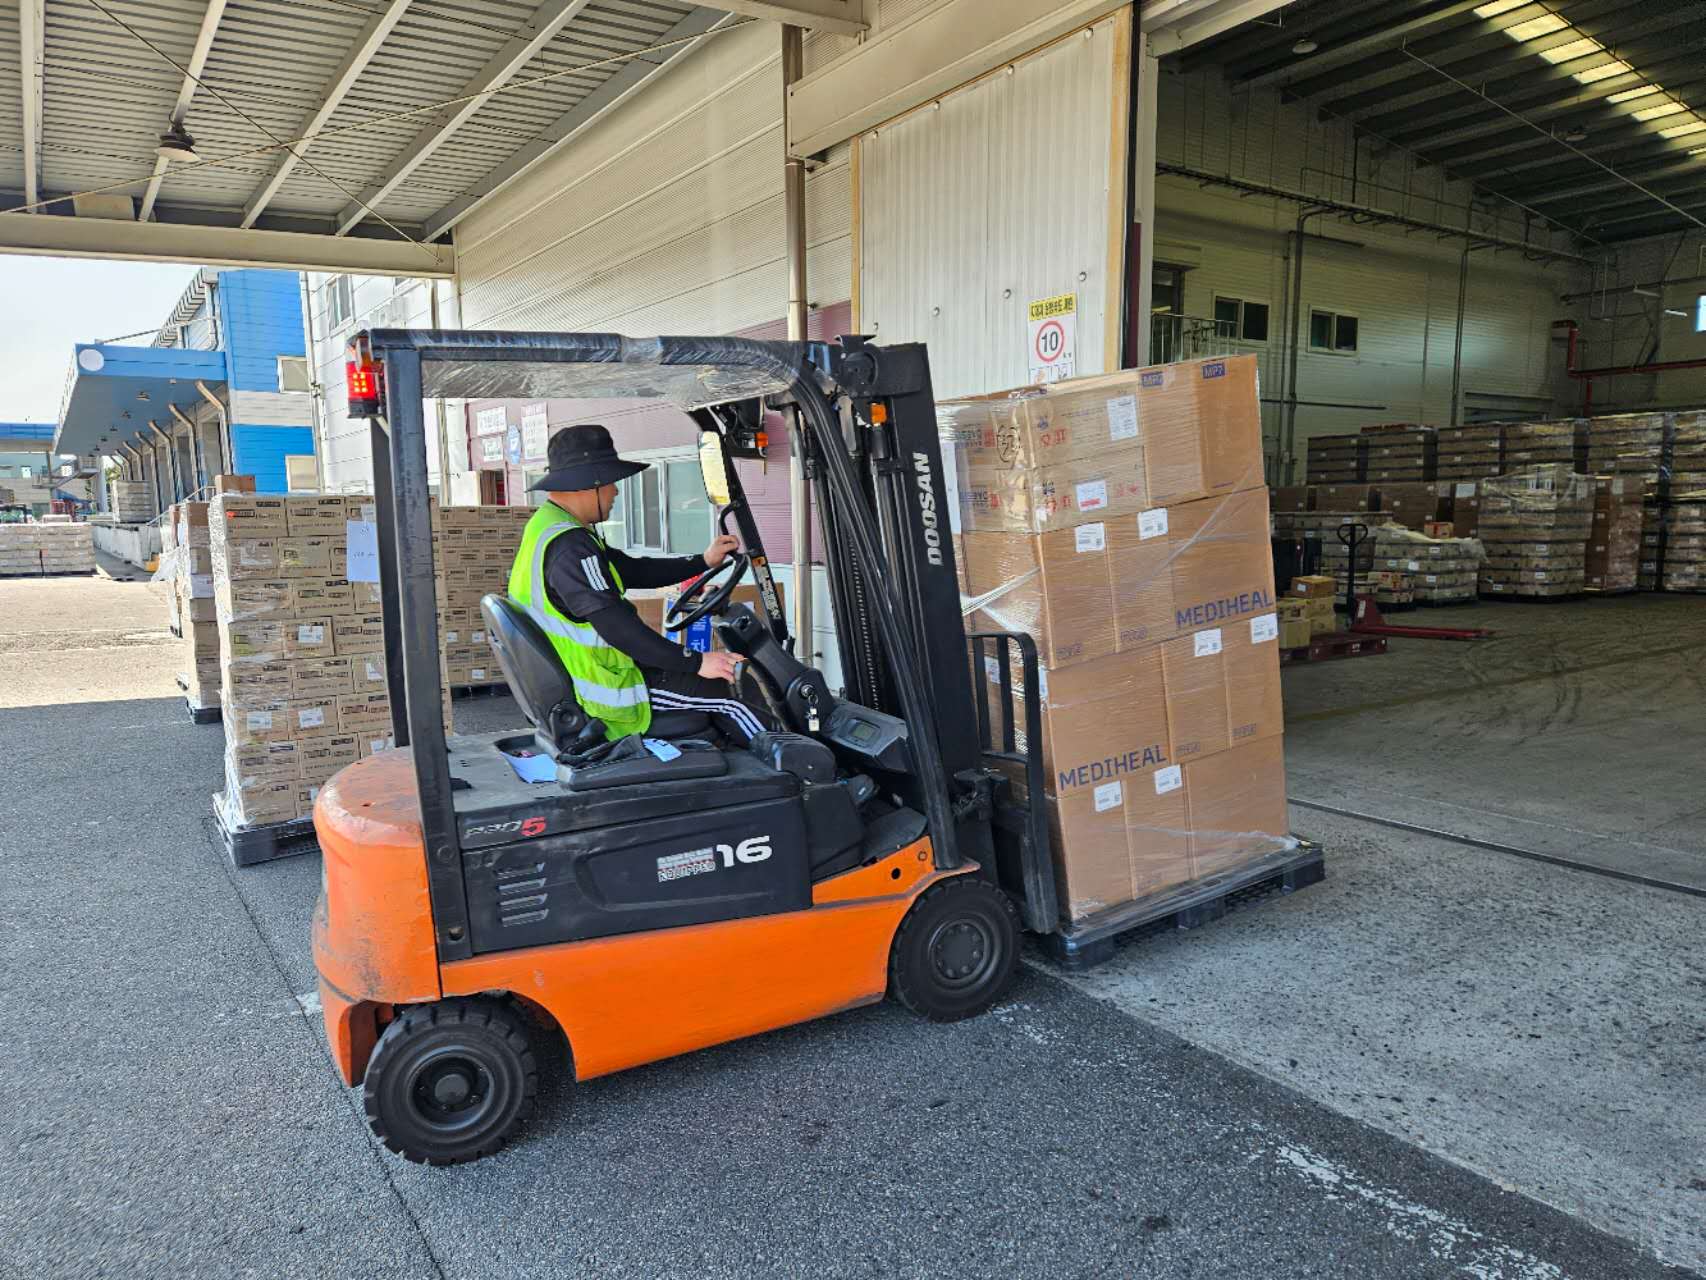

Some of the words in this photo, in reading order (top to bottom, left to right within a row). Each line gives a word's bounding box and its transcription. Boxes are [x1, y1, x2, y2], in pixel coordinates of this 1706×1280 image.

[1041, 331, 1059, 353] 10
[912, 452, 944, 566] DOOSAN
[1176, 589, 1274, 628] MEDIHEAL
[1059, 744, 1167, 790] MEDIHEAL
[716, 835, 772, 868] 16
